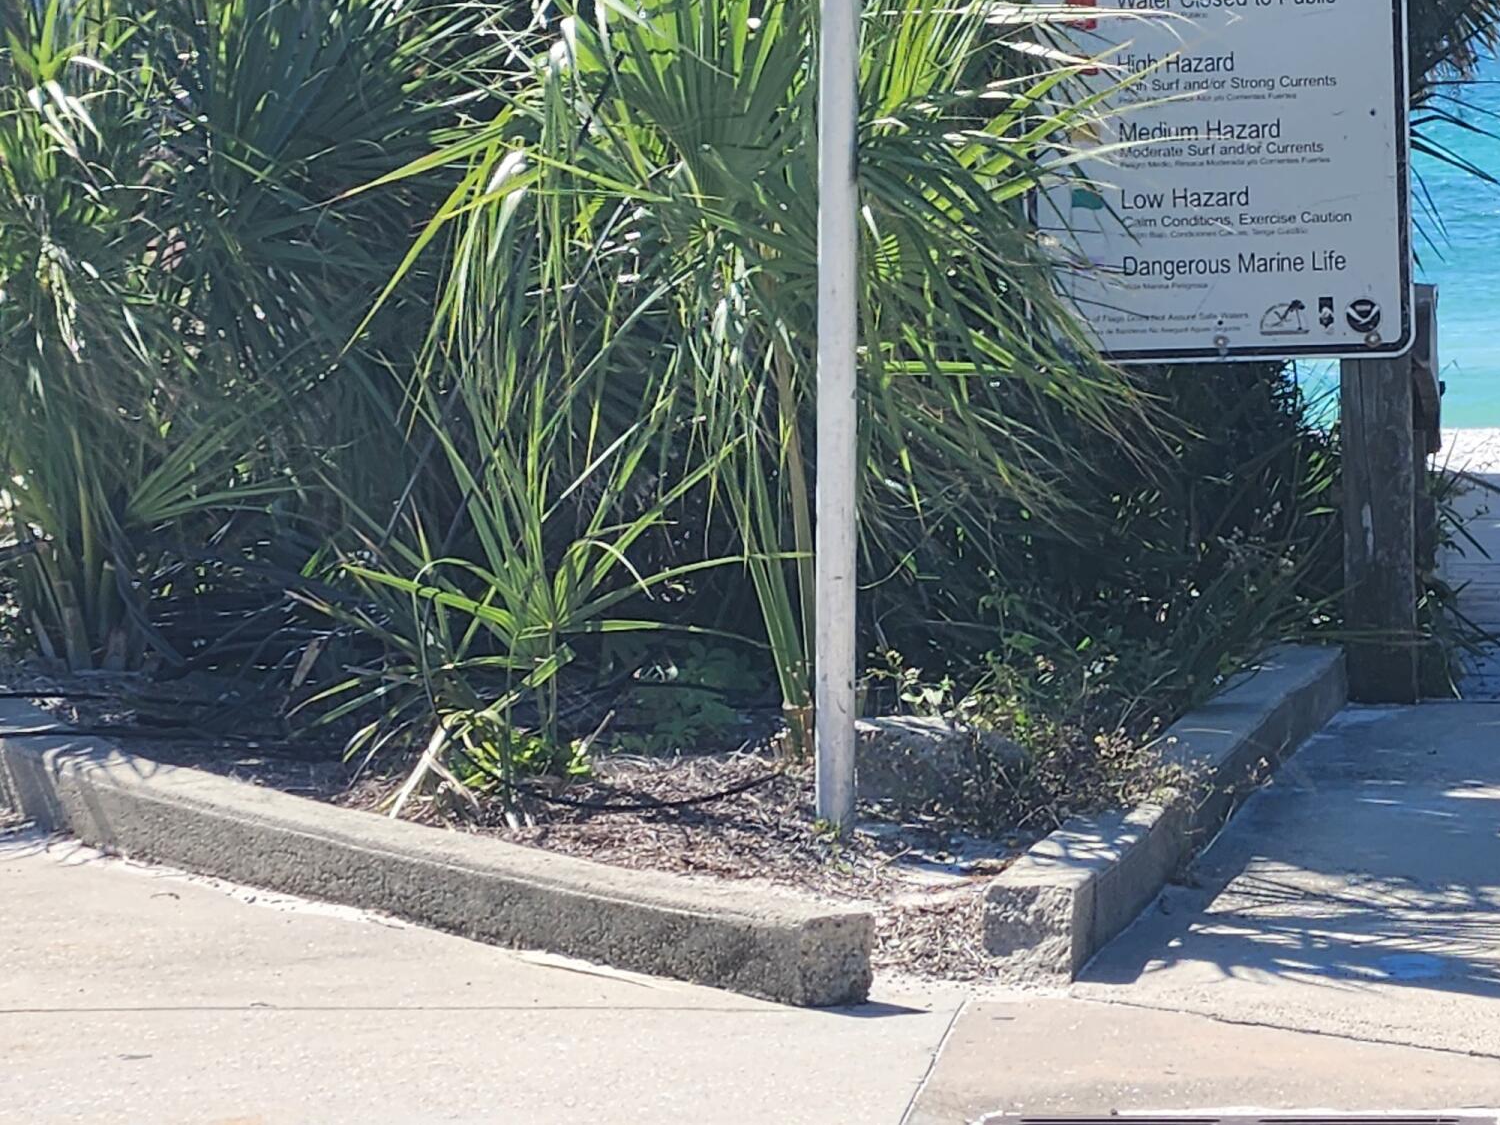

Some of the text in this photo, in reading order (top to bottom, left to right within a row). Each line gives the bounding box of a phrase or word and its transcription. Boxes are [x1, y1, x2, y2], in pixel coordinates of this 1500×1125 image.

[1117, 51, 1234, 80] High Hazard
[1152, 78, 1180, 91] Surf
[1184, 78, 1226, 91] and/or
[1231, 76, 1275, 90] Strong
[1280, 75, 1337, 88] Currents
[1120, 117, 1280, 142] Medium Hazard
[1120, 142, 1325, 158] Moderate Surf and/or Currents
[1121, 186, 1249, 209] Low Hazard
[1122, 216, 1157, 229] Calm
[1238, 212, 1297, 225] Exercise
[1301, 211, 1353, 224] Caution
[1123, 250, 1346, 281] Dangerous Marine Life
